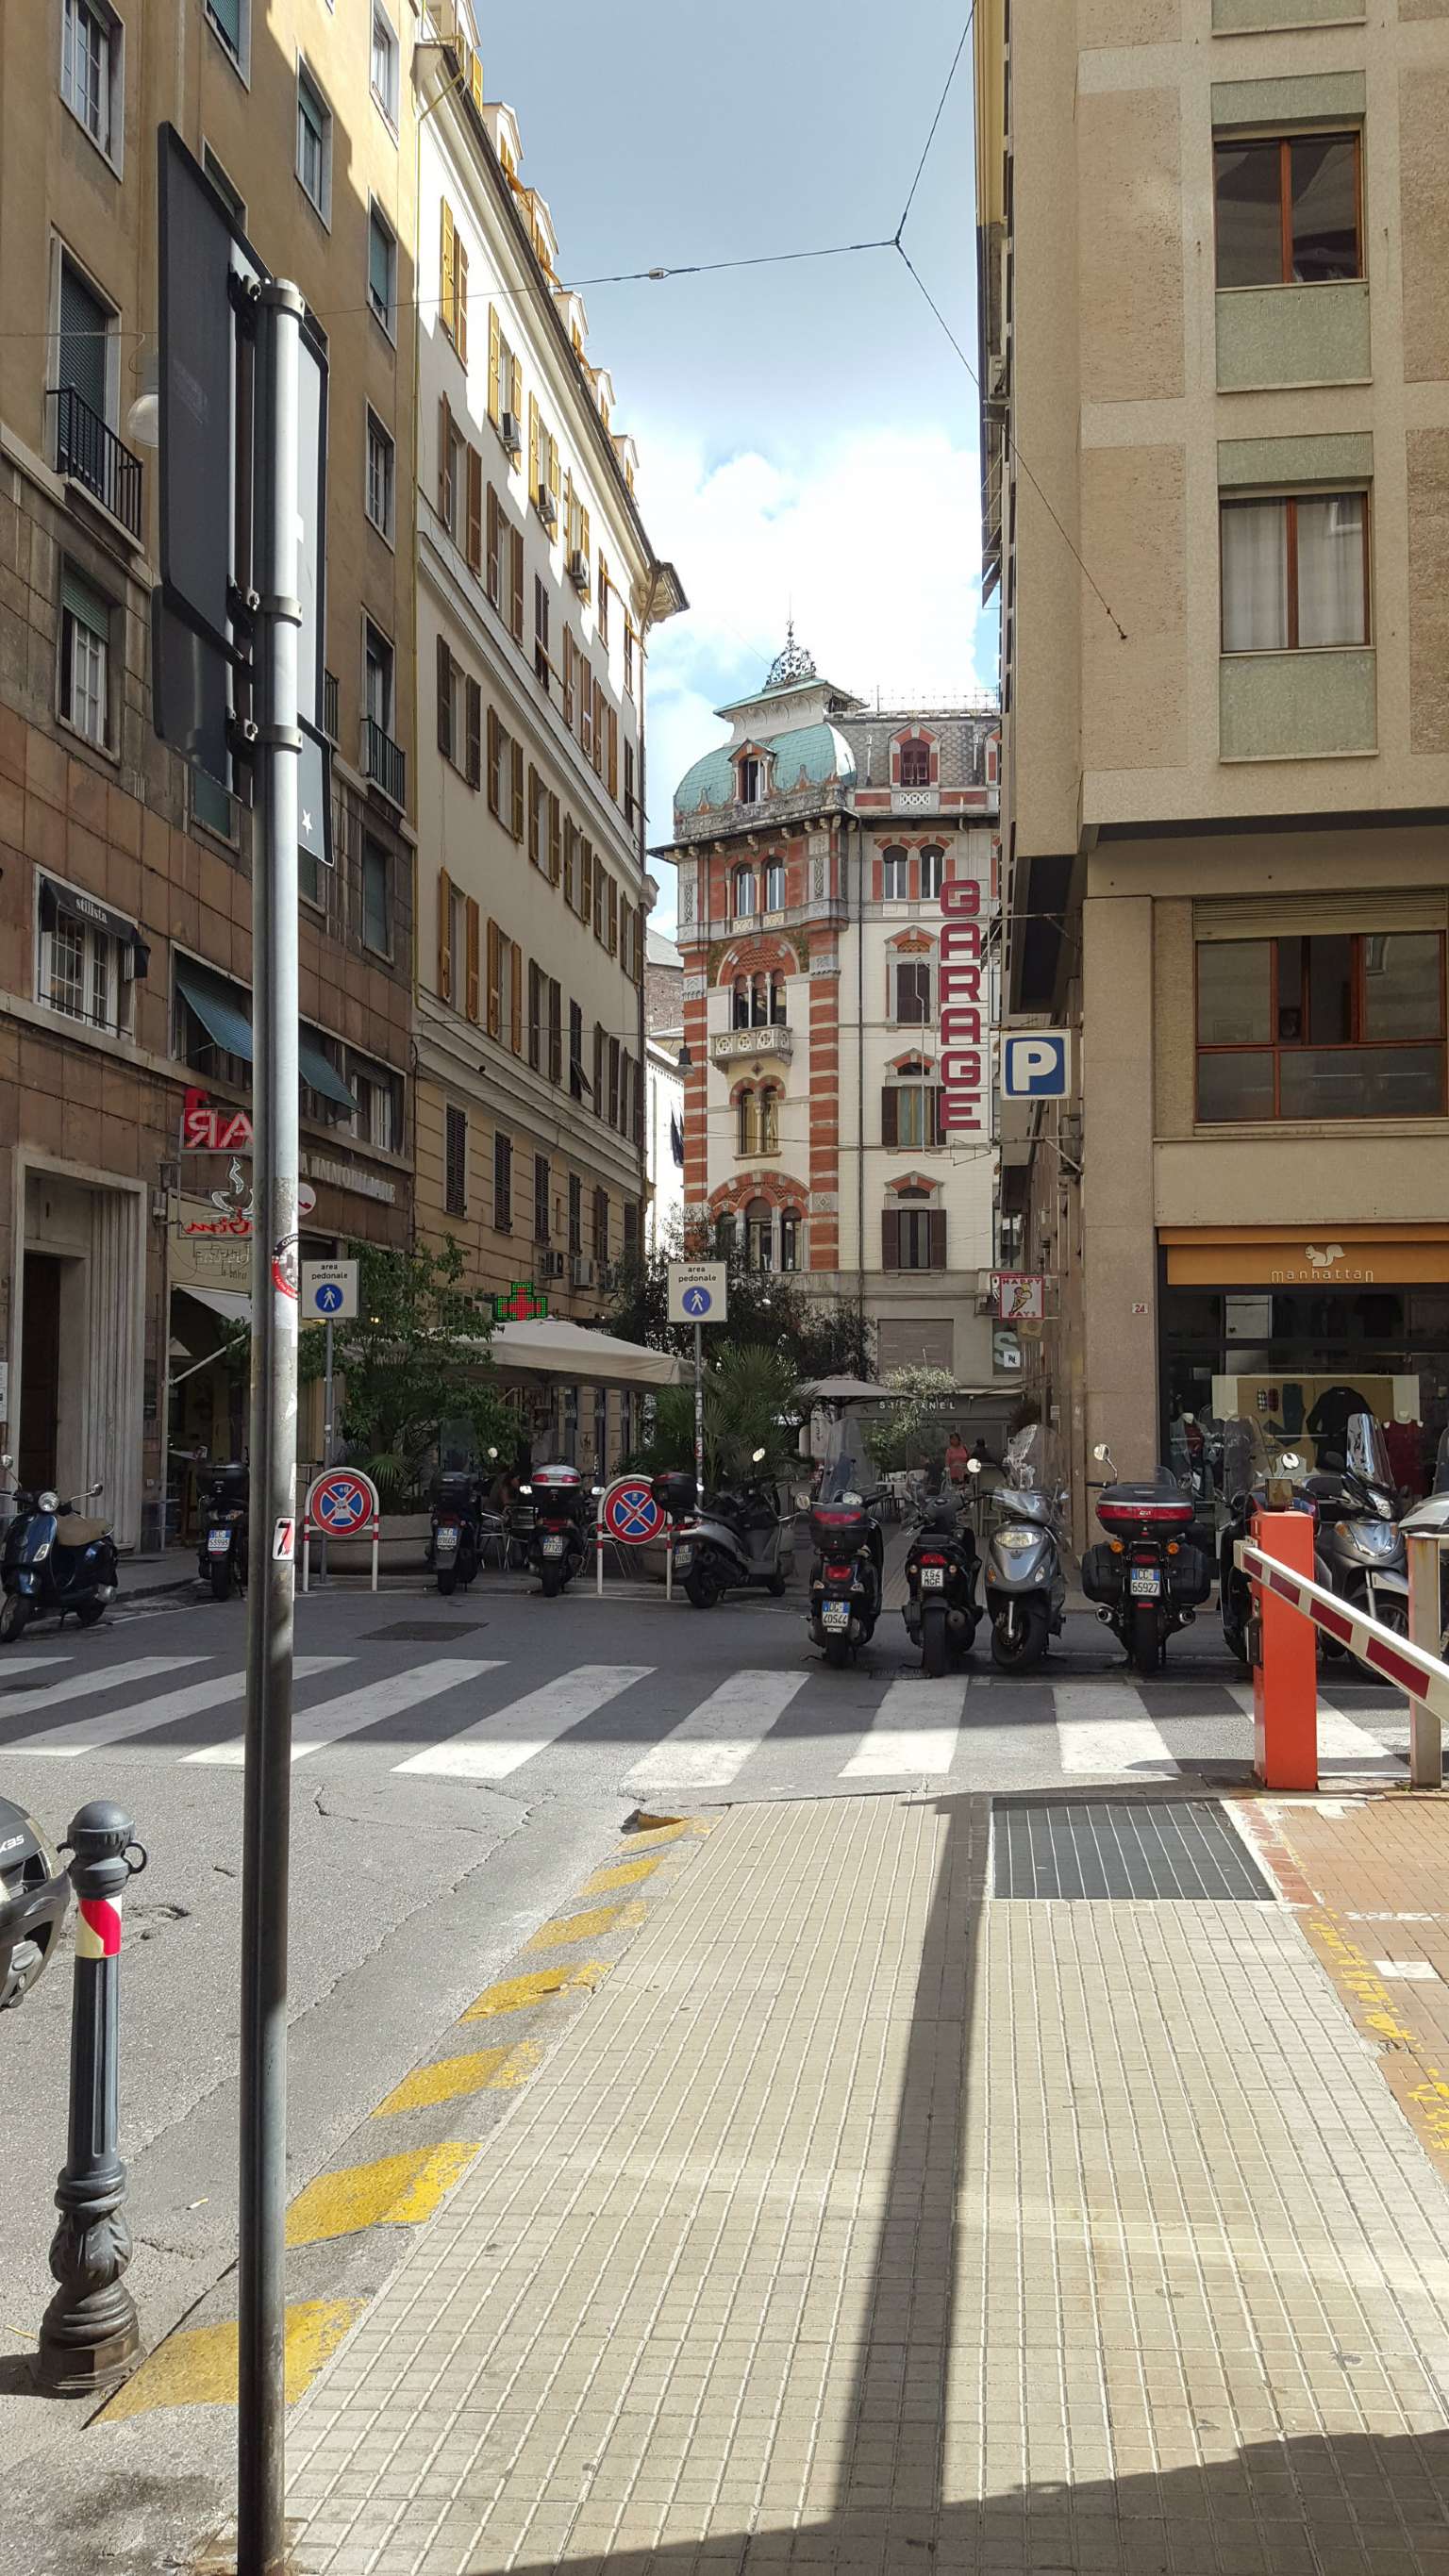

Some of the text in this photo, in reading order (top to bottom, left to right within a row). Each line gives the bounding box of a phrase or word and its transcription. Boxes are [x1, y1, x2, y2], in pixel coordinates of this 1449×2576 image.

[941, 880, 980, 1129] GARAGE
[1012, 1040, 1058, 1091] P
[311, 1271, 348, 1281] pedonale
[678, 1273, 717, 1283] pedonale
[1271, 1267, 1374, 1283] manhattan
[1135, 1304, 1145, 1313] 24
[1132, 1582, 1158, 1593] 65927
